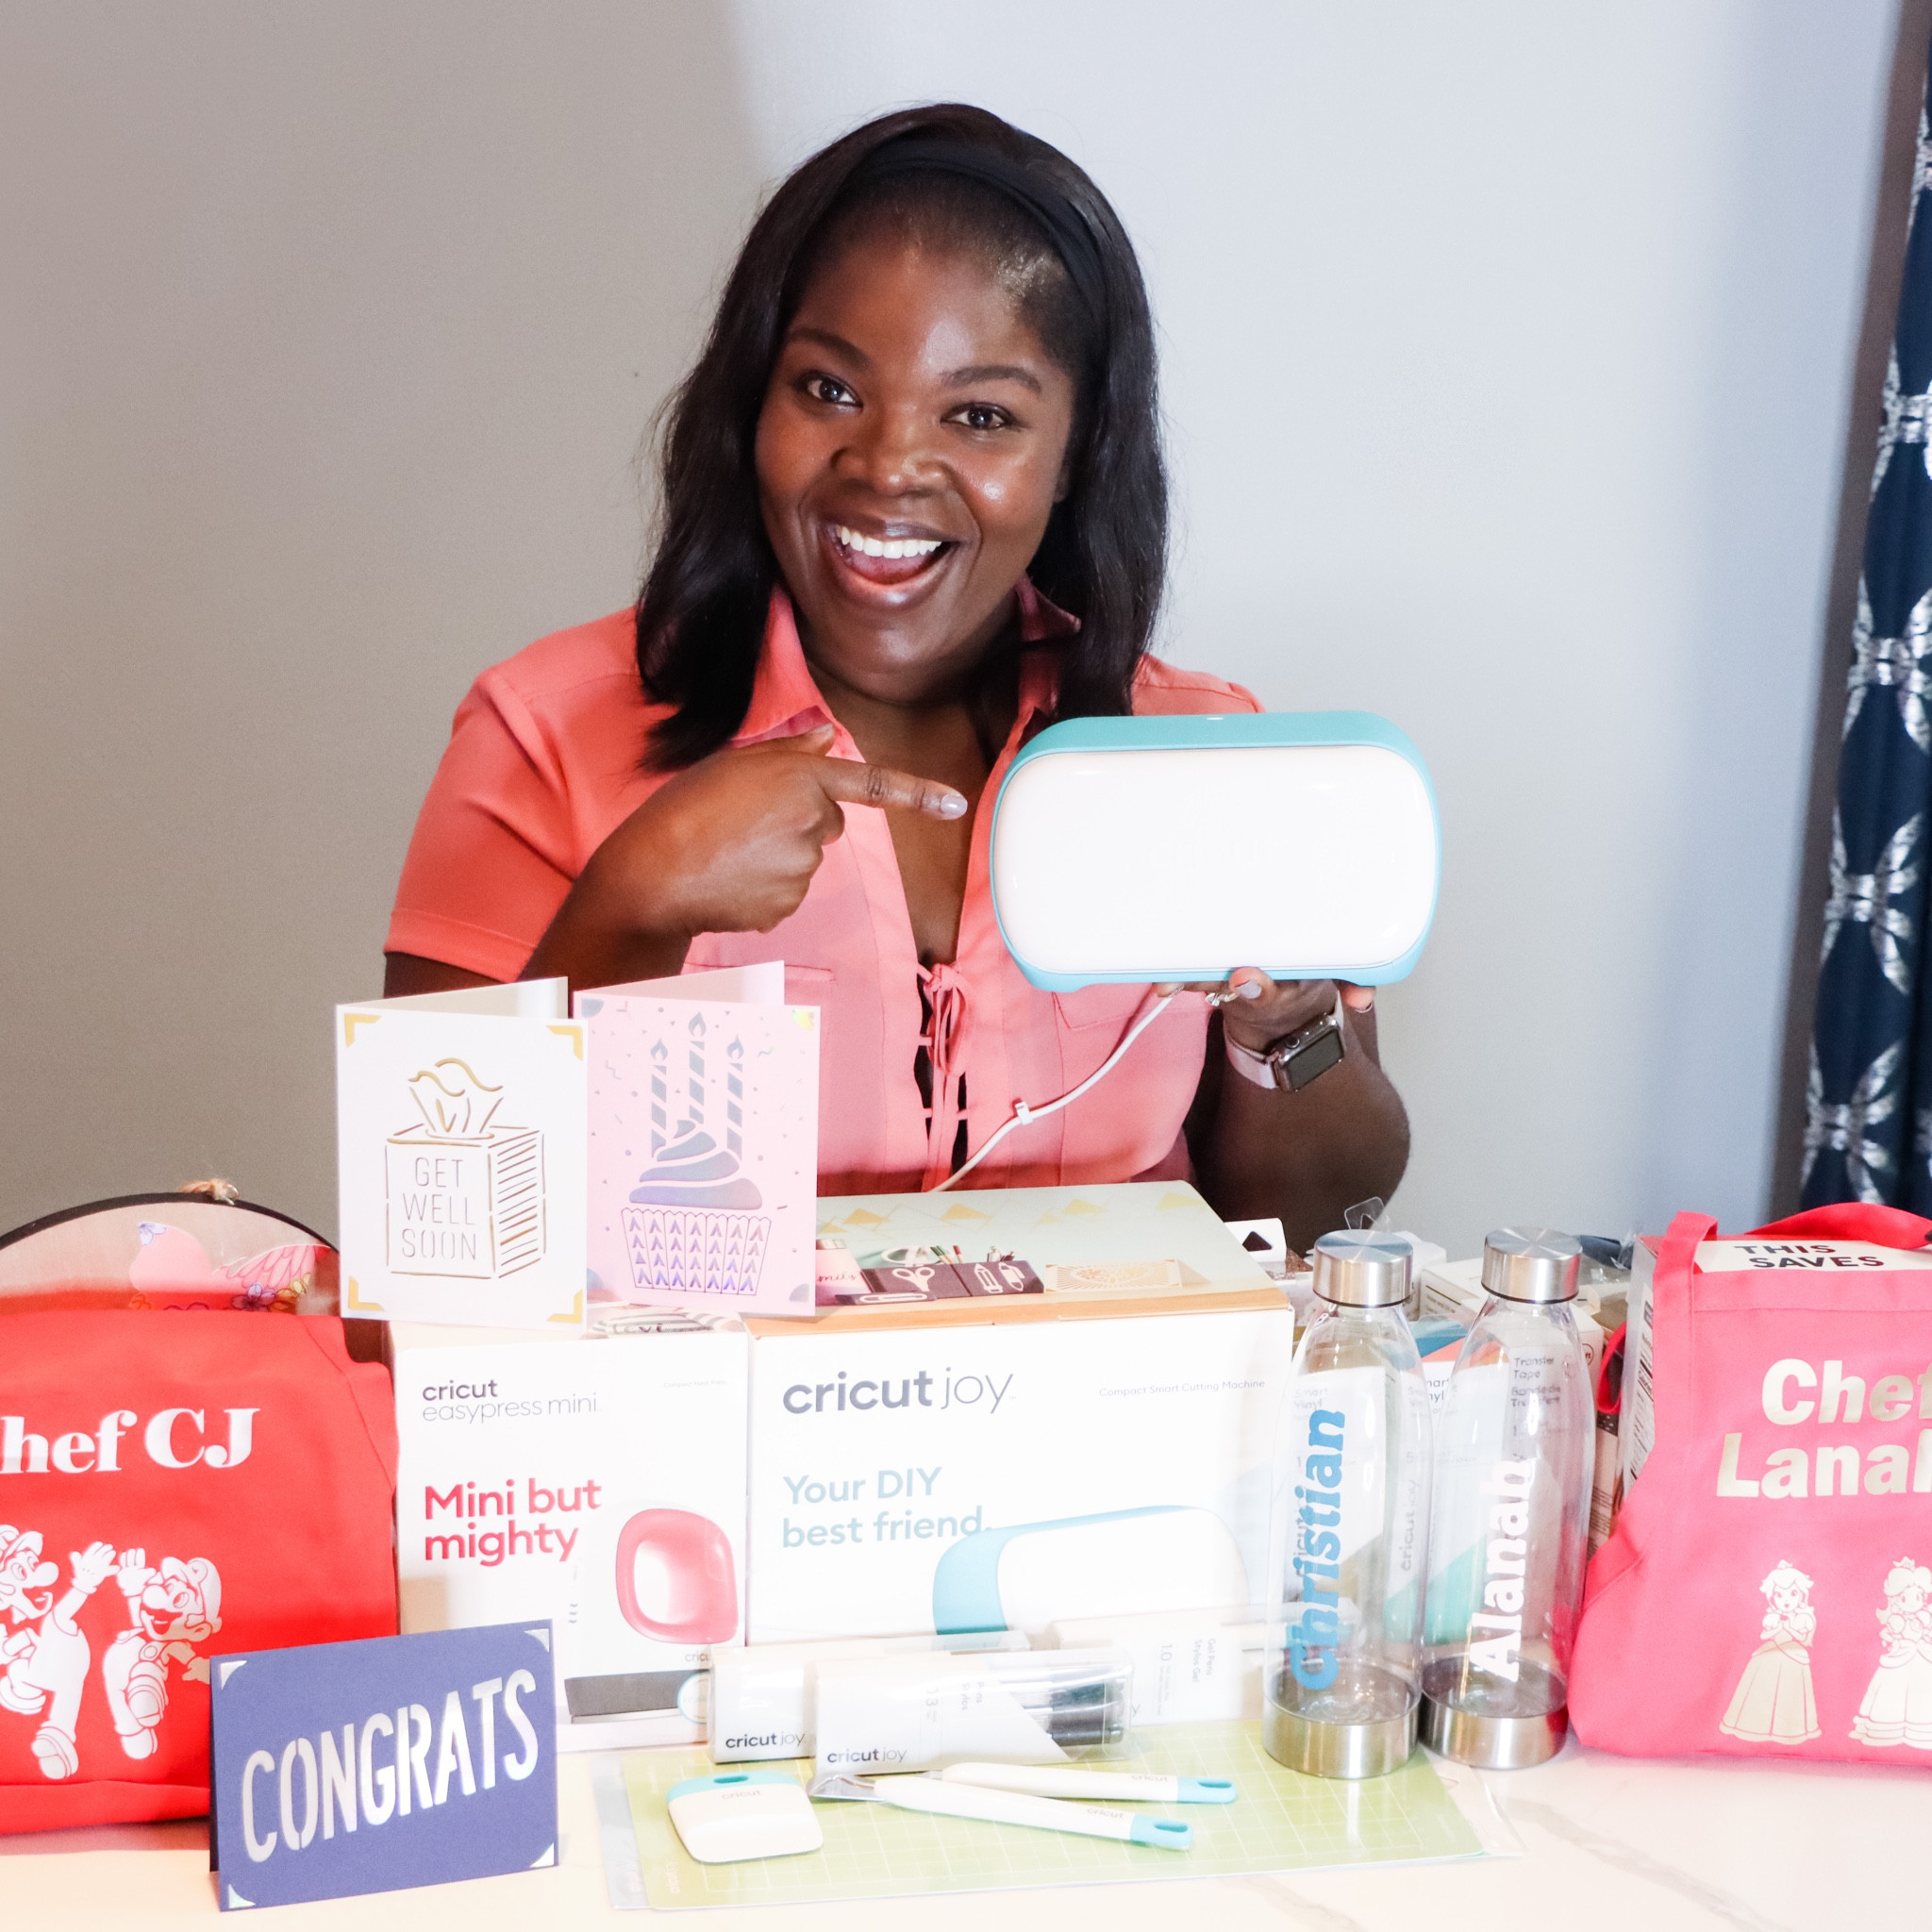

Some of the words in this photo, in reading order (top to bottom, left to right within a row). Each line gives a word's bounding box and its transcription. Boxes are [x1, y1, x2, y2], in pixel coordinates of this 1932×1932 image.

[414, 1157, 464, 1189] GET
[401, 1192, 475, 1226] WELL
[400, 1227, 478, 1262] SOON
[1734, 1244, 1837, 1255] THIS
[1748, 1256, 1886, 1268] SAVES
[422, 1378, 498, 1402] cricut
[782, 1370, 933, 1414] cricut
[940, 1366, 1014, 1415] joy
[1098, 1385, 1145, 1399] Compact
[1148, 1383, 1179, 1394] Smart
[1181, 1381, 1220, 1394] Cutting
[1222, 1379, 1266, 1391] Machine
[1513, 1370, 1541, 1381] Tape
[422, 1399, 543, 1424] easypress
[547, 1392, 598, 1415] mini
[0, 1410, 138, 1474] hef
[144, 1407, 261, 1469] CJ
[425, 1479, 515, 1520] Mini
[527, 1477, 602, 1514] but
[782, 1473, 866, 1505] Your
[876, 1466, 943, 1500] DIY
[425, 1519, 579, 1567] mighty
[782, 1513, 862, 1548] best
[1290, 1408, 1346, 1690] Christian
[1469, 1458, 1531, 1683] Alanah
[724, 1732, 776, 1750] cricut
[778, 1731, 806, 1748] joy
[826, 1748, 879, 1764] cricut
[880, 1745, 908, 1764] joy
[242, 1668, 540, 1863] CONGRATS
[721, 1789, 762, 1800] cricut
[1086, 1807, 1125, 1819] cricut
